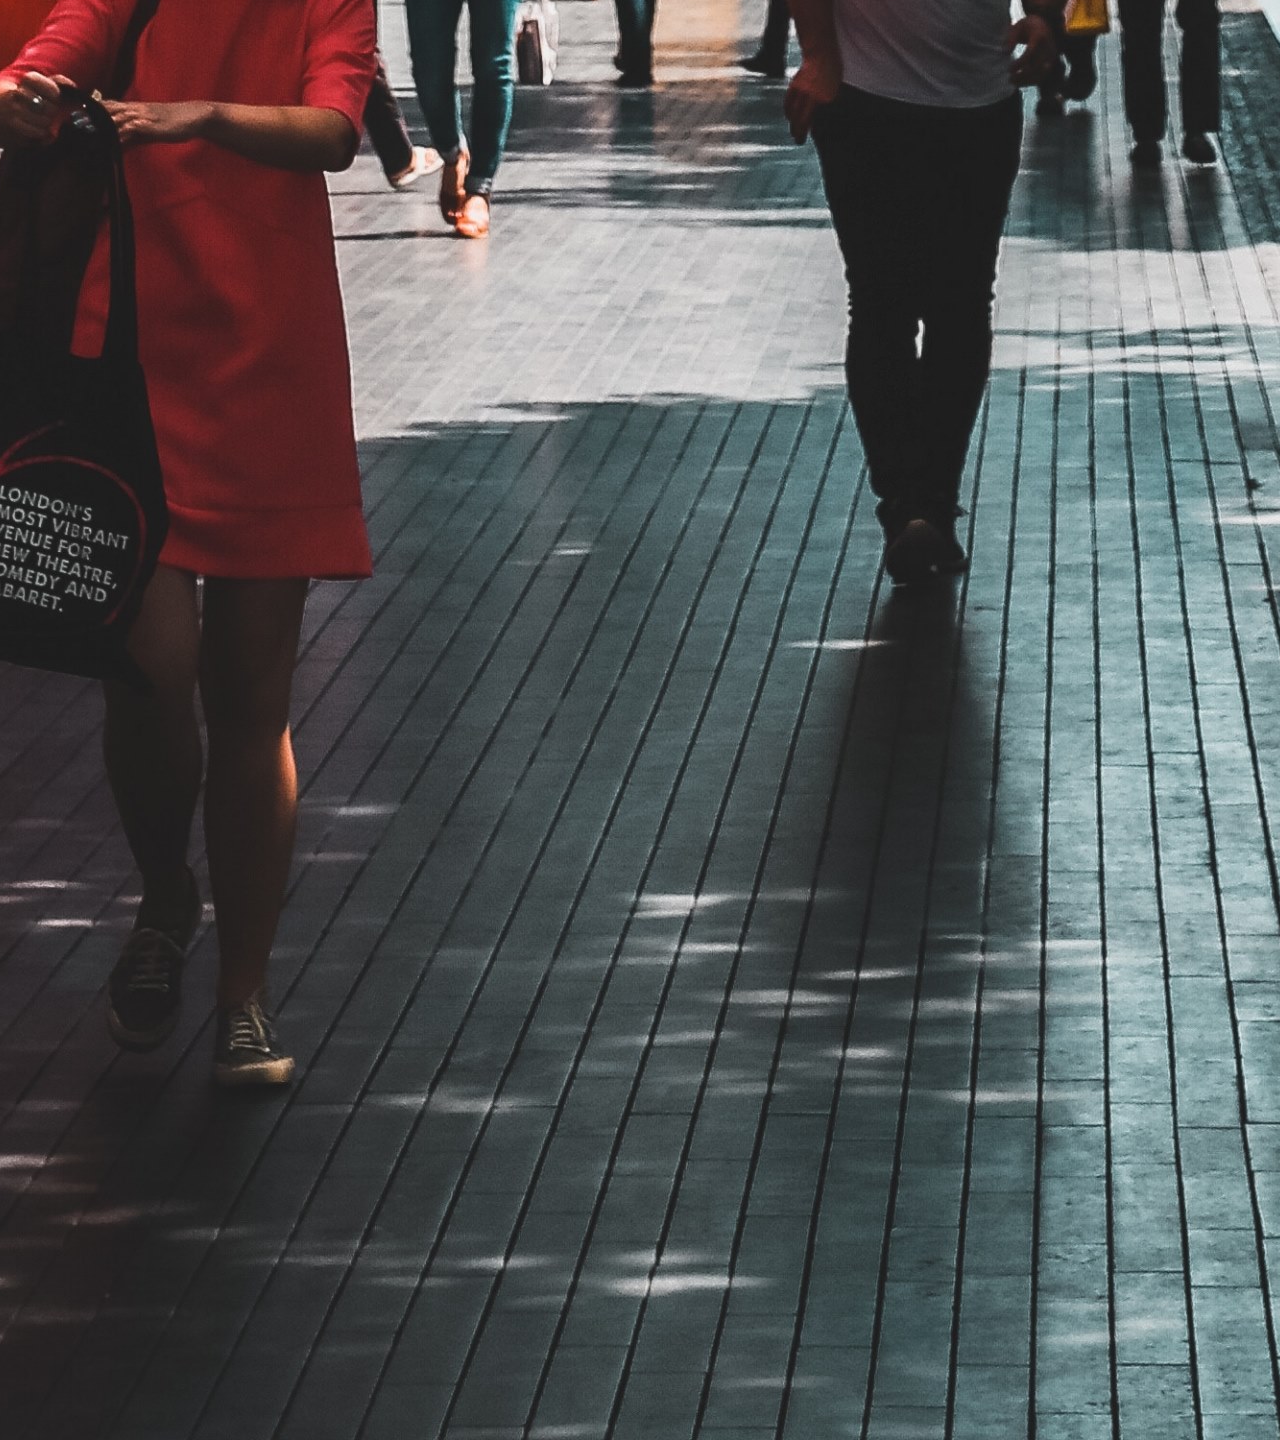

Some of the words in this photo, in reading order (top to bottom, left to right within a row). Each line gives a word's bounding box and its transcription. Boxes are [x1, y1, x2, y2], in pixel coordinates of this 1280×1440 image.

[52, 517, 129, 550] VIBRANT
[57, 539, 92, 561] FOR
[36, 551, 117, 589] THEATRE,
[64, 581, 108, 602] AND
